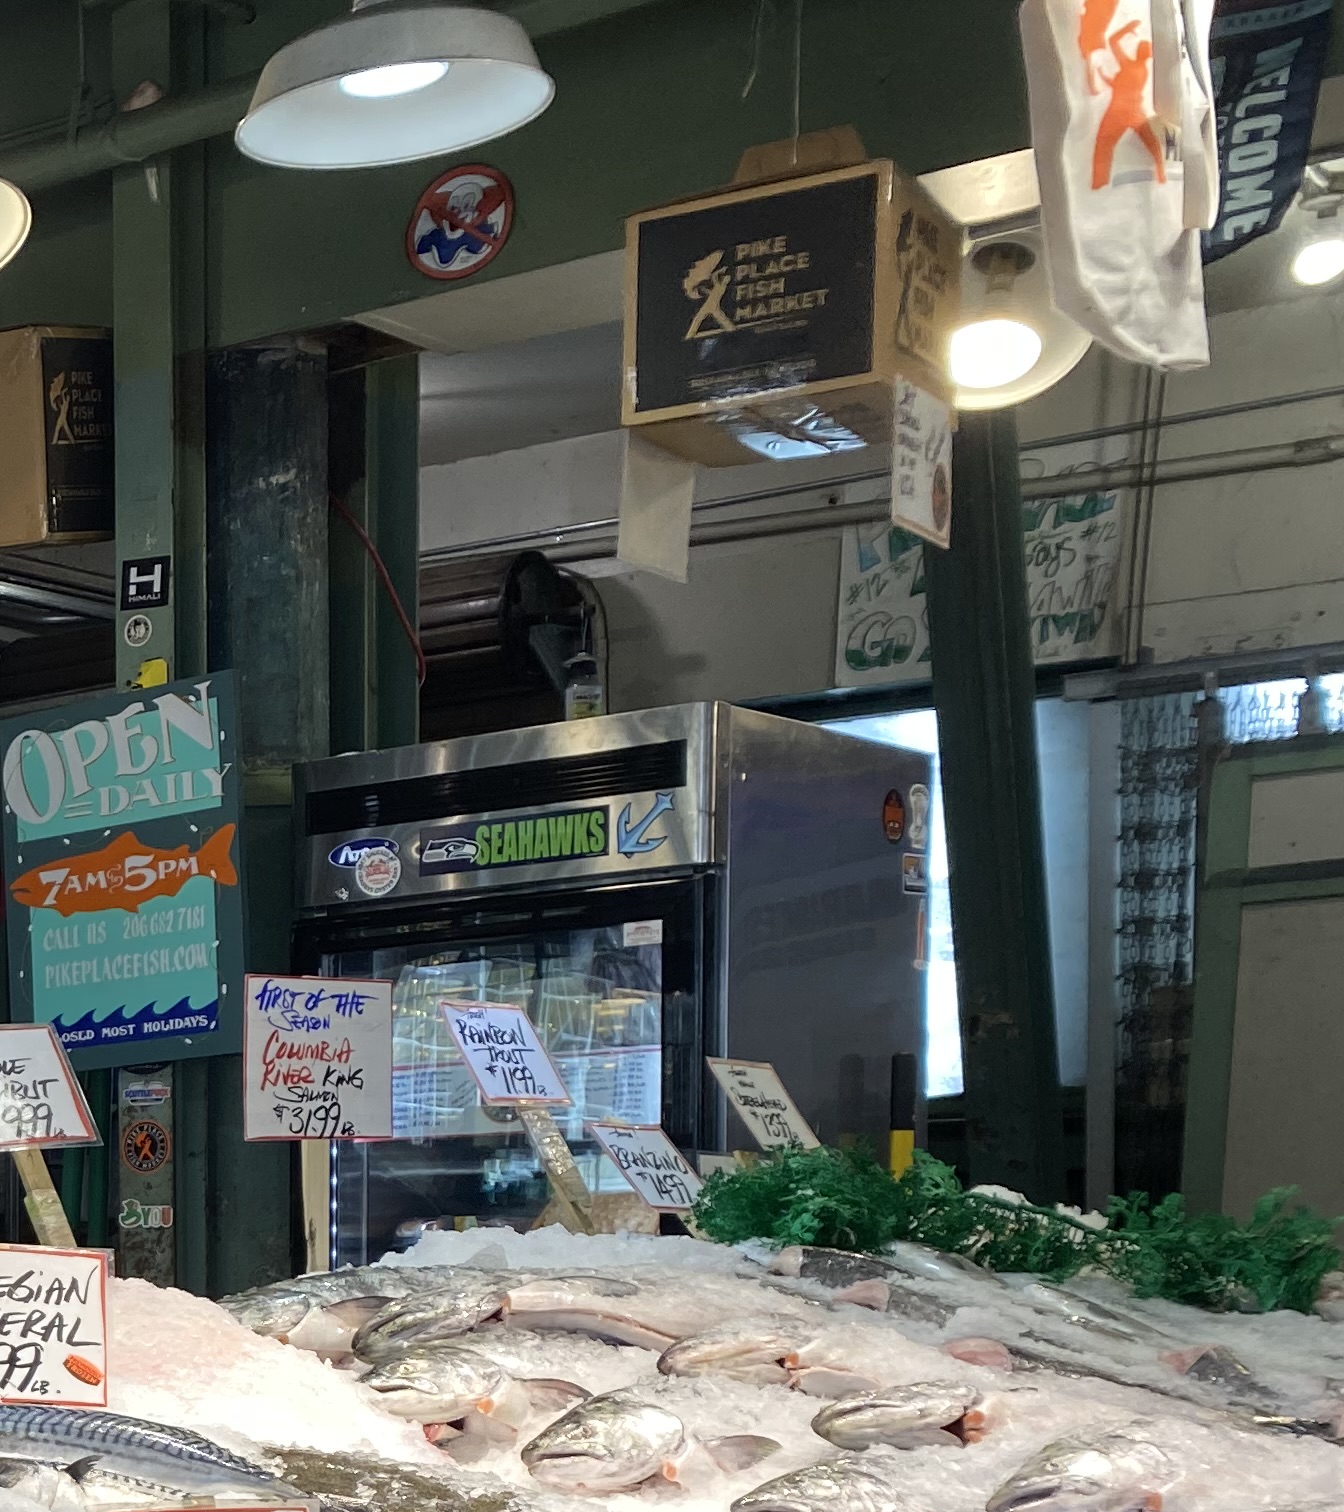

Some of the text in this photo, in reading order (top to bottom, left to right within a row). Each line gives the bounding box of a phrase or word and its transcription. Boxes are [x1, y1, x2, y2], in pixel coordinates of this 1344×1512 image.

[735, 235, 787, 262] PIKE
[735, 252, 810, 282] PLACE
[735, 277, 785, 301] FISH
[735, 288, 830, 321] MARKET
[3, 680, 212, 824] OPEN
[98, 762, 232, 816] DAILY
[475, 808, 606, 865] SEAHAWKS
[38, 854, 200, 907] 7AM 5PM
[43, 904, 206, 951] CALL US 206 682 7181
[45, 942, 209, 990] PIKEPLACEFISH.COM
[101, 1014, 209, 1039] MOST HOLIDAYS
[456, 1018, 527, 1047] RAINBOW
[141, 1207, 172, 1227] YOU
